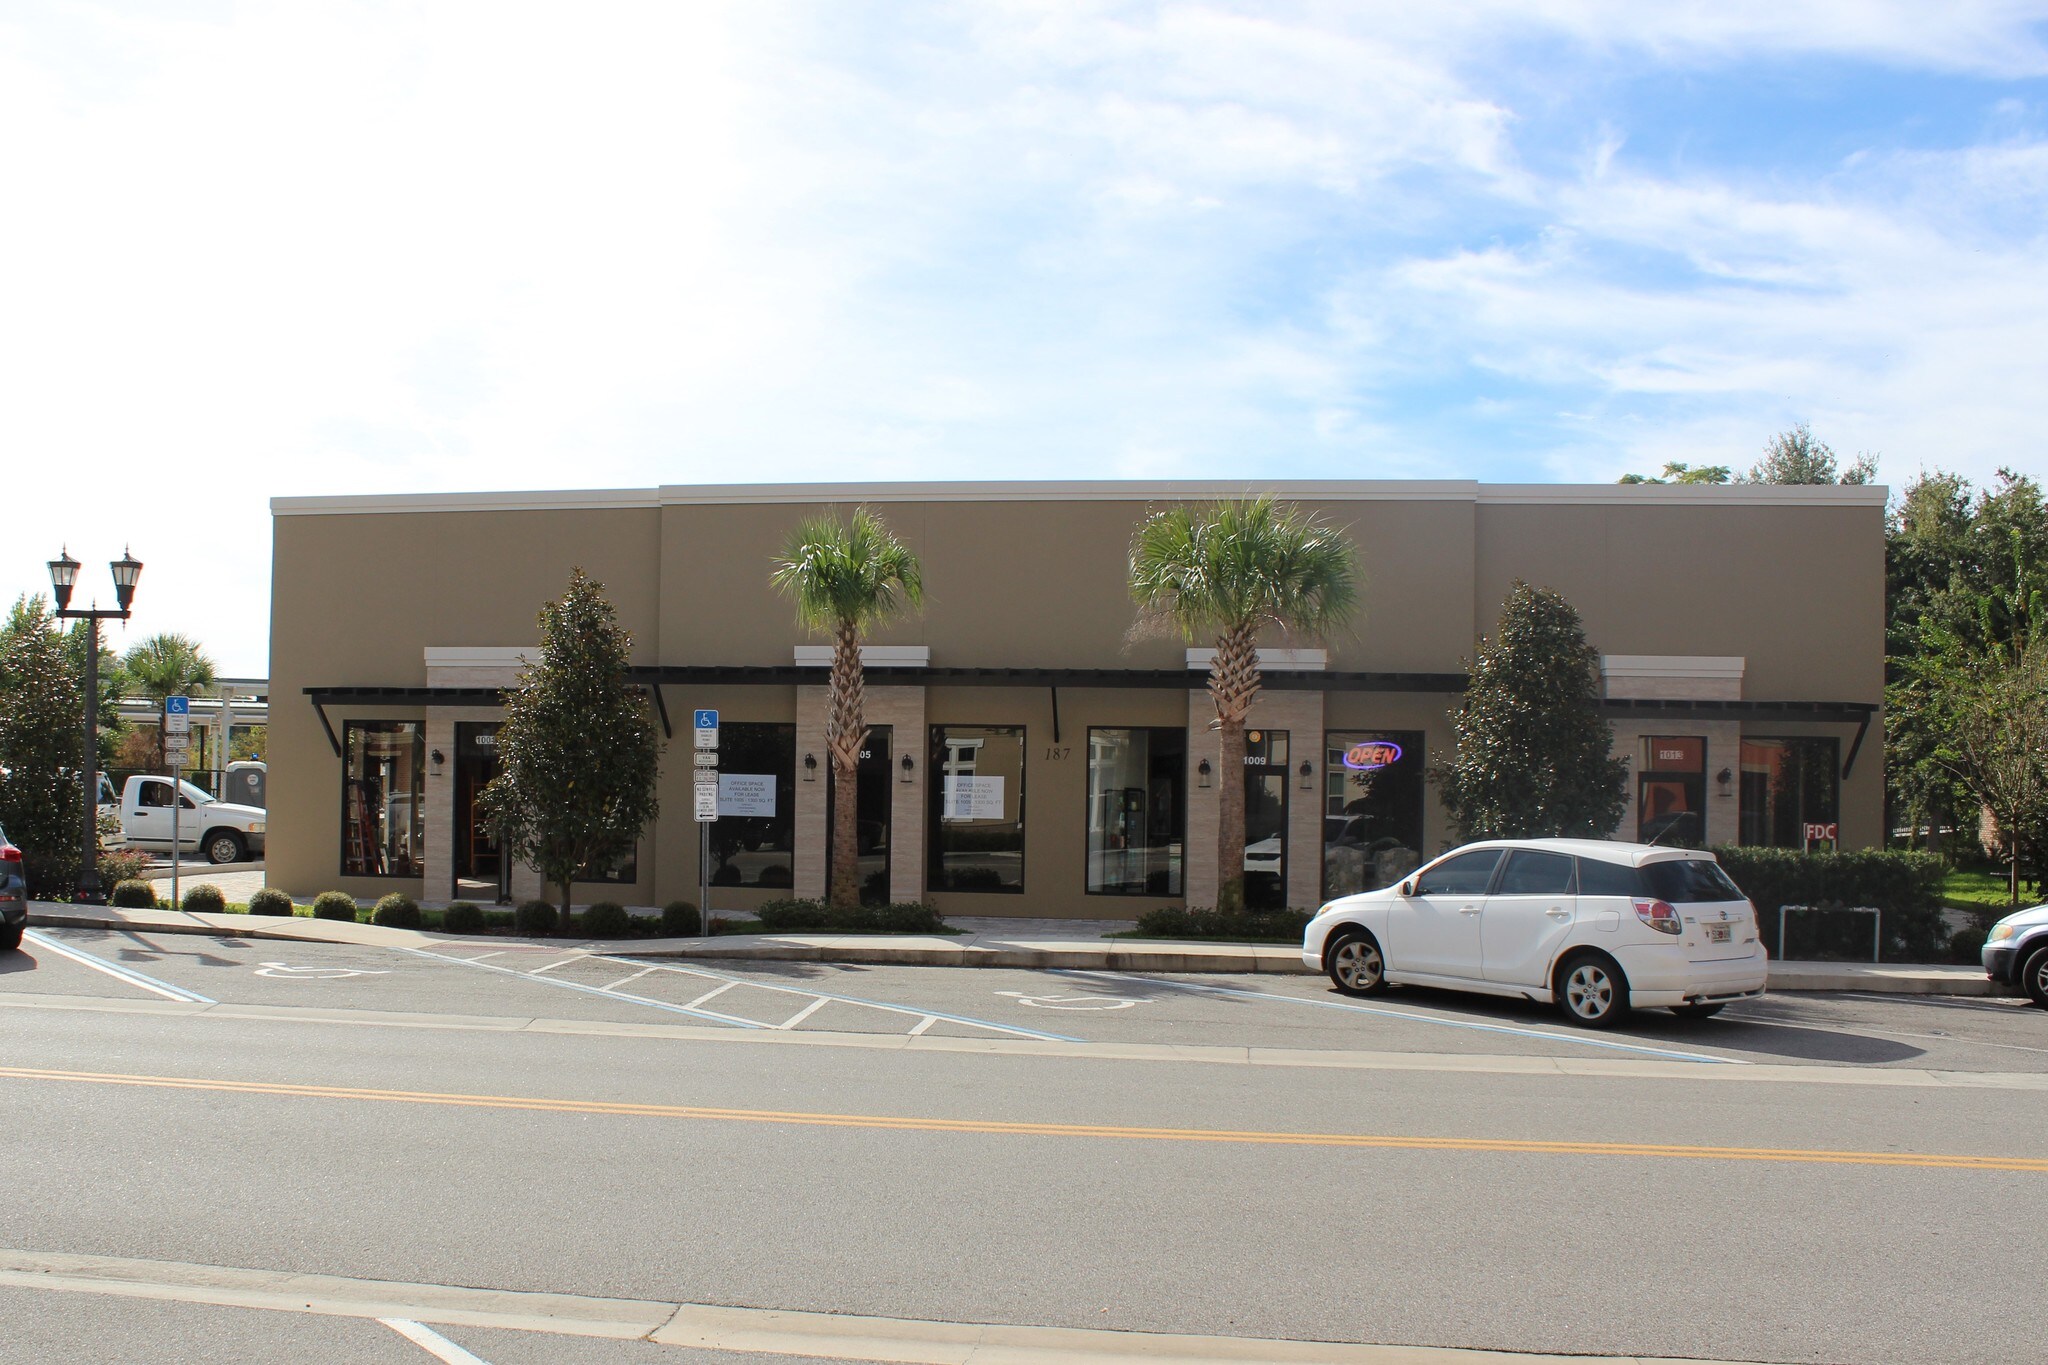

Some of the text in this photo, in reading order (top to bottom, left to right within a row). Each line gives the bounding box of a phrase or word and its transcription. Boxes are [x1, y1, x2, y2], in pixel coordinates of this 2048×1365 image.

[1045, 747, 1071, 761] 187
[1243, 756, 1267, 766] 1009
[1348, 746, 1396, 764] OPEN
[1660, 750, 1684, 760] 1013
[1806, 824, 1835, 840] FDC
